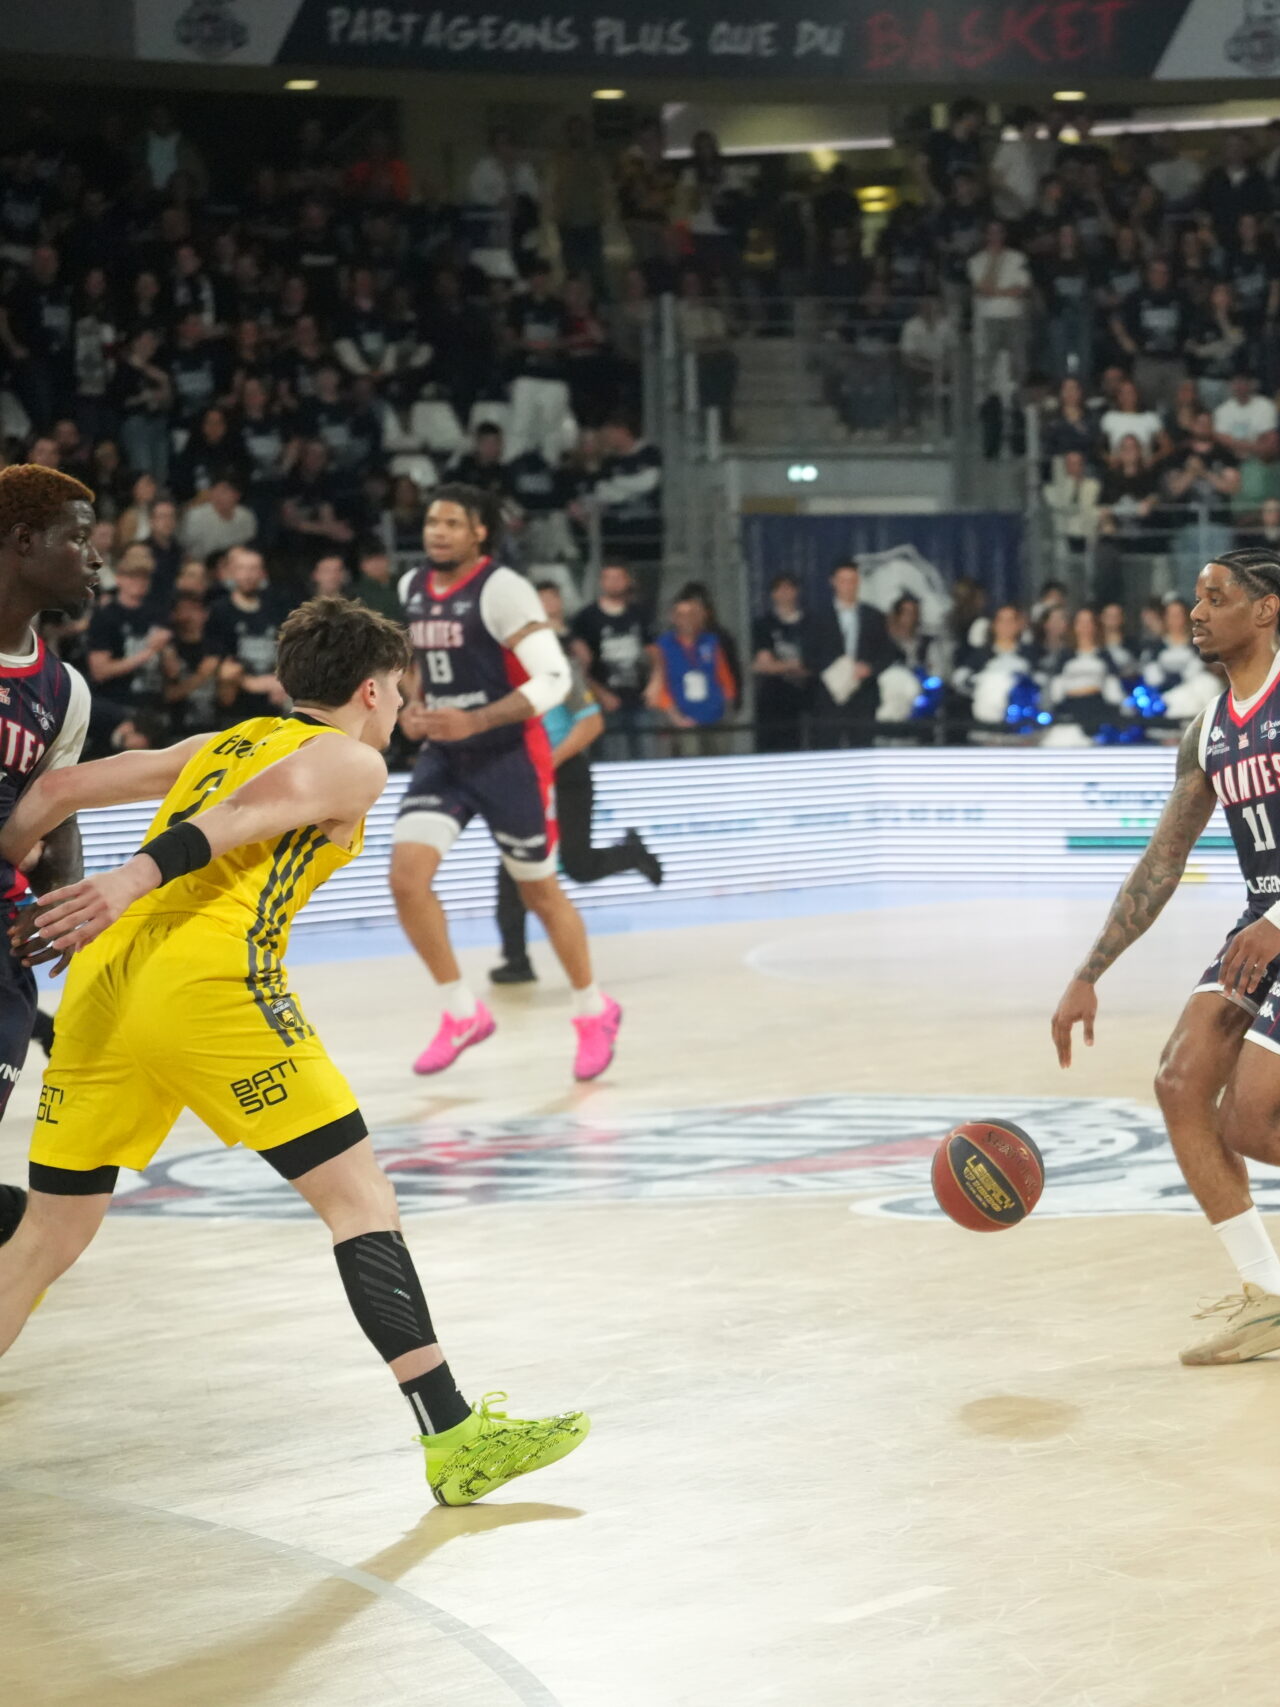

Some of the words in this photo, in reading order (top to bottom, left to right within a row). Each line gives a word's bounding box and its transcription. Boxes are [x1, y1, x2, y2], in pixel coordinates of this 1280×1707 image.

[326, 6, 579, 52] PARTAGEONS
[592, 17, 691, 57] PLUS
[707, 21, 779, 57] QUE
[795, 20, 848, 58] DU
[865, 2, 1130, 71] BASKET
[1242, 803, 1276, 852] 11
[230, 1058, 298, 1097] BATI
